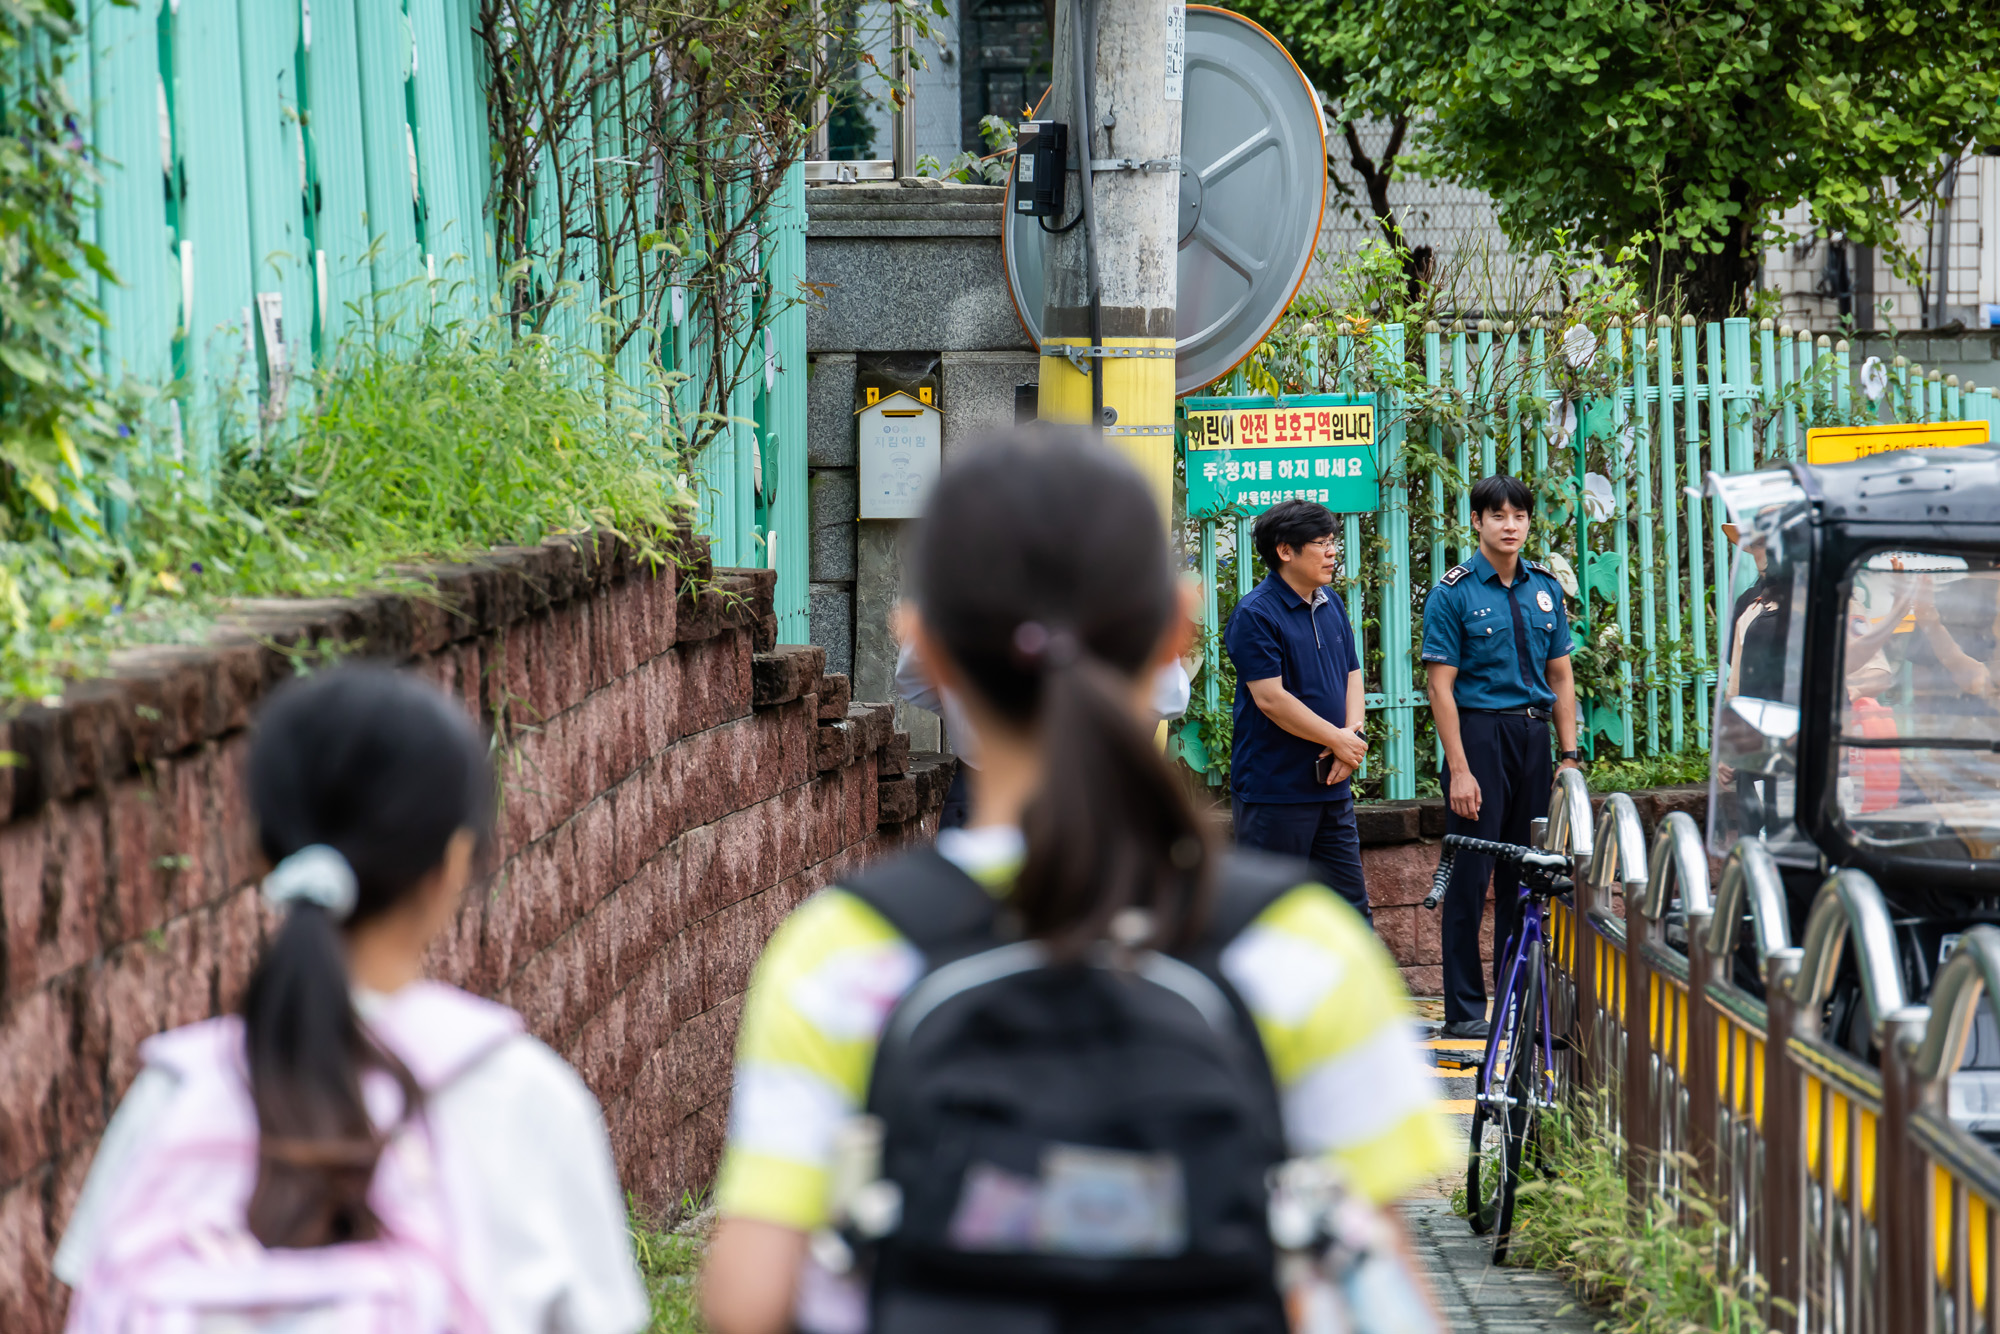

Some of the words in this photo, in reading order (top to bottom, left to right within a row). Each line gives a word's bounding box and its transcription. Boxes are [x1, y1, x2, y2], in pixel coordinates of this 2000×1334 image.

[1239, 413, 1269, 444] 안전
[1274, 411, 1371, 442] 보호구역입니다
[1278, 459, 1309, 480] 하지
[1315, 457, 1363, 478] 마세요
